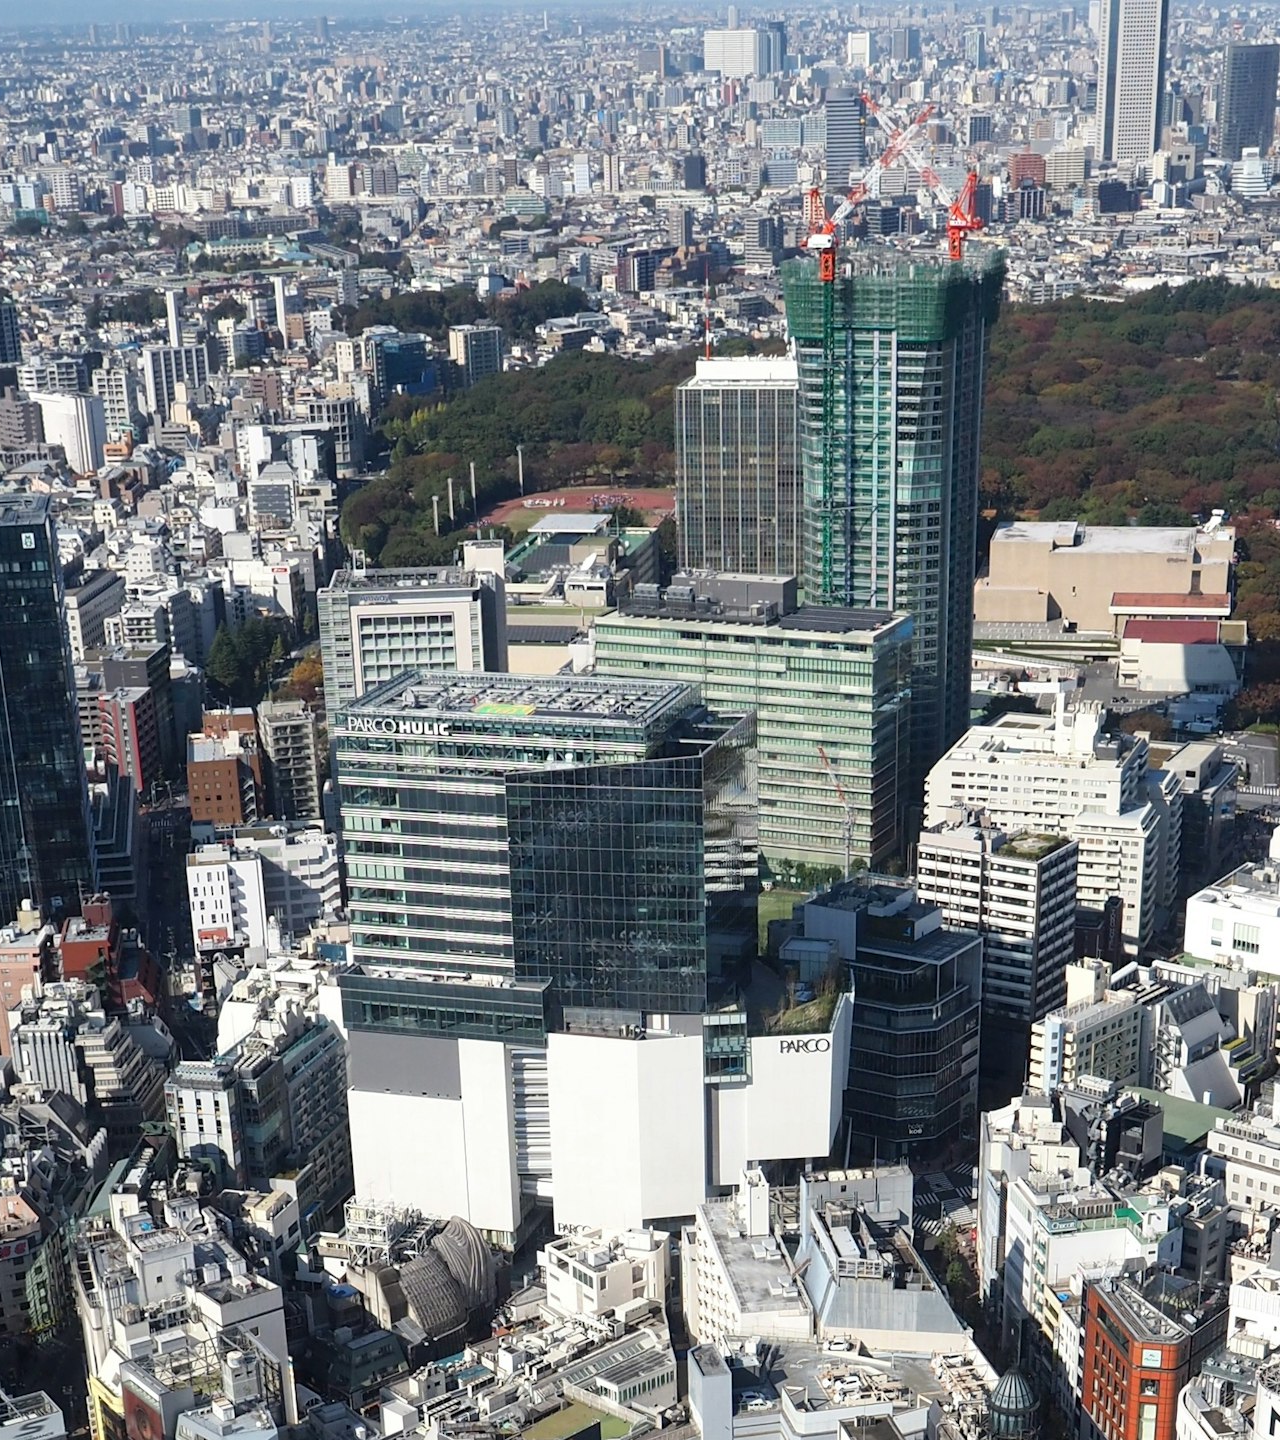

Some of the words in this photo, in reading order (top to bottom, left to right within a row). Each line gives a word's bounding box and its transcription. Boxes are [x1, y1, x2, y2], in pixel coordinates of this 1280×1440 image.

[347, 716, 397, 734] PARCO
[399, 721, 450, 736] HULIC
[780, 1037, 831, 1054] PARCO
